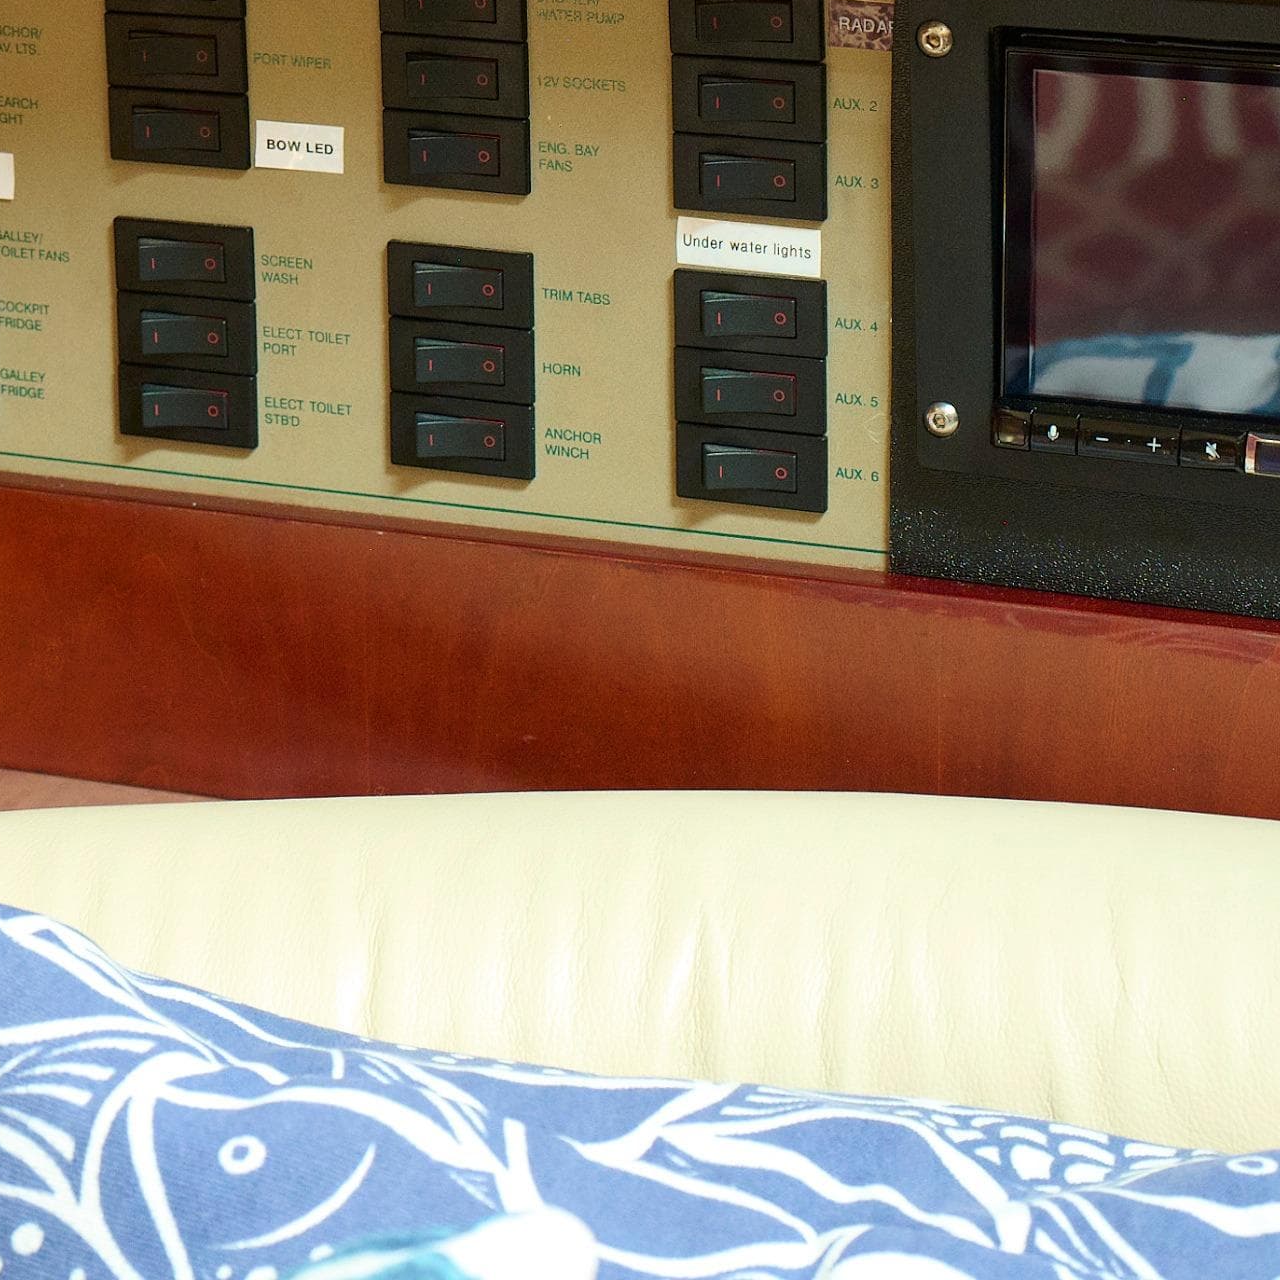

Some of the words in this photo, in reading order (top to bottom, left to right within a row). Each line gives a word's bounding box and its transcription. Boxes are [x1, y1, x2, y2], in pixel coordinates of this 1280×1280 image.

[536, 9, 584, 24] WATER
[585, 11, 625, 26] PUMP
[252, 51, 287, 67] PORT
[290, 54, 332, 70] WIPER
[536, 75, 560, 89] 12V
[563, 77, 626, 93] SOCKETS
[832, 97, 865, 112] AUX.
[869, 100, 878, 113] 2
[266, 138, 302, 153] BOW
[305, 140, 334, 156] LED
[538, 141, 571, 157] ENG.
[574, 143, 601, 158] BAY
[538, 158, 573, 173] FANS
[834, 175, 867, 189] AUX.
[870, 177, 880, 190] 3
[682, 233, 724, 251] Under
[730, 241, 769, 255] water
[773, 242, 813, 261] lights
[38, 248, 71, 264] FANS
[260, 254, 314, 270] SCREEN
[262, 271, 300, 286] WASH
[541, 287, 574, 303] TRIM
[577, 291, 611, 306] TABS
[834, 317, 867, 331] AUX.
[869, 320, 879, 333] 4
[308, 330, 351, 346] TOILET
[263, 342, 297, 357] PORT
[0, 368, 46, 384] GALLEY
[542, 362, 582, 378] HORN
[0, 384, 45, 401] FRIDGE
[834, 392, 867, 406] AUX.
[870, 395, 880, 408] 5
[309, 400, 352, 417] TOILET
[544, 426, 603, 445] ANCHOR
[544, 443, 591, 461] WINCH
[834, 466, 867, 481] AUX.
[870, 470, 880, 483] 6
